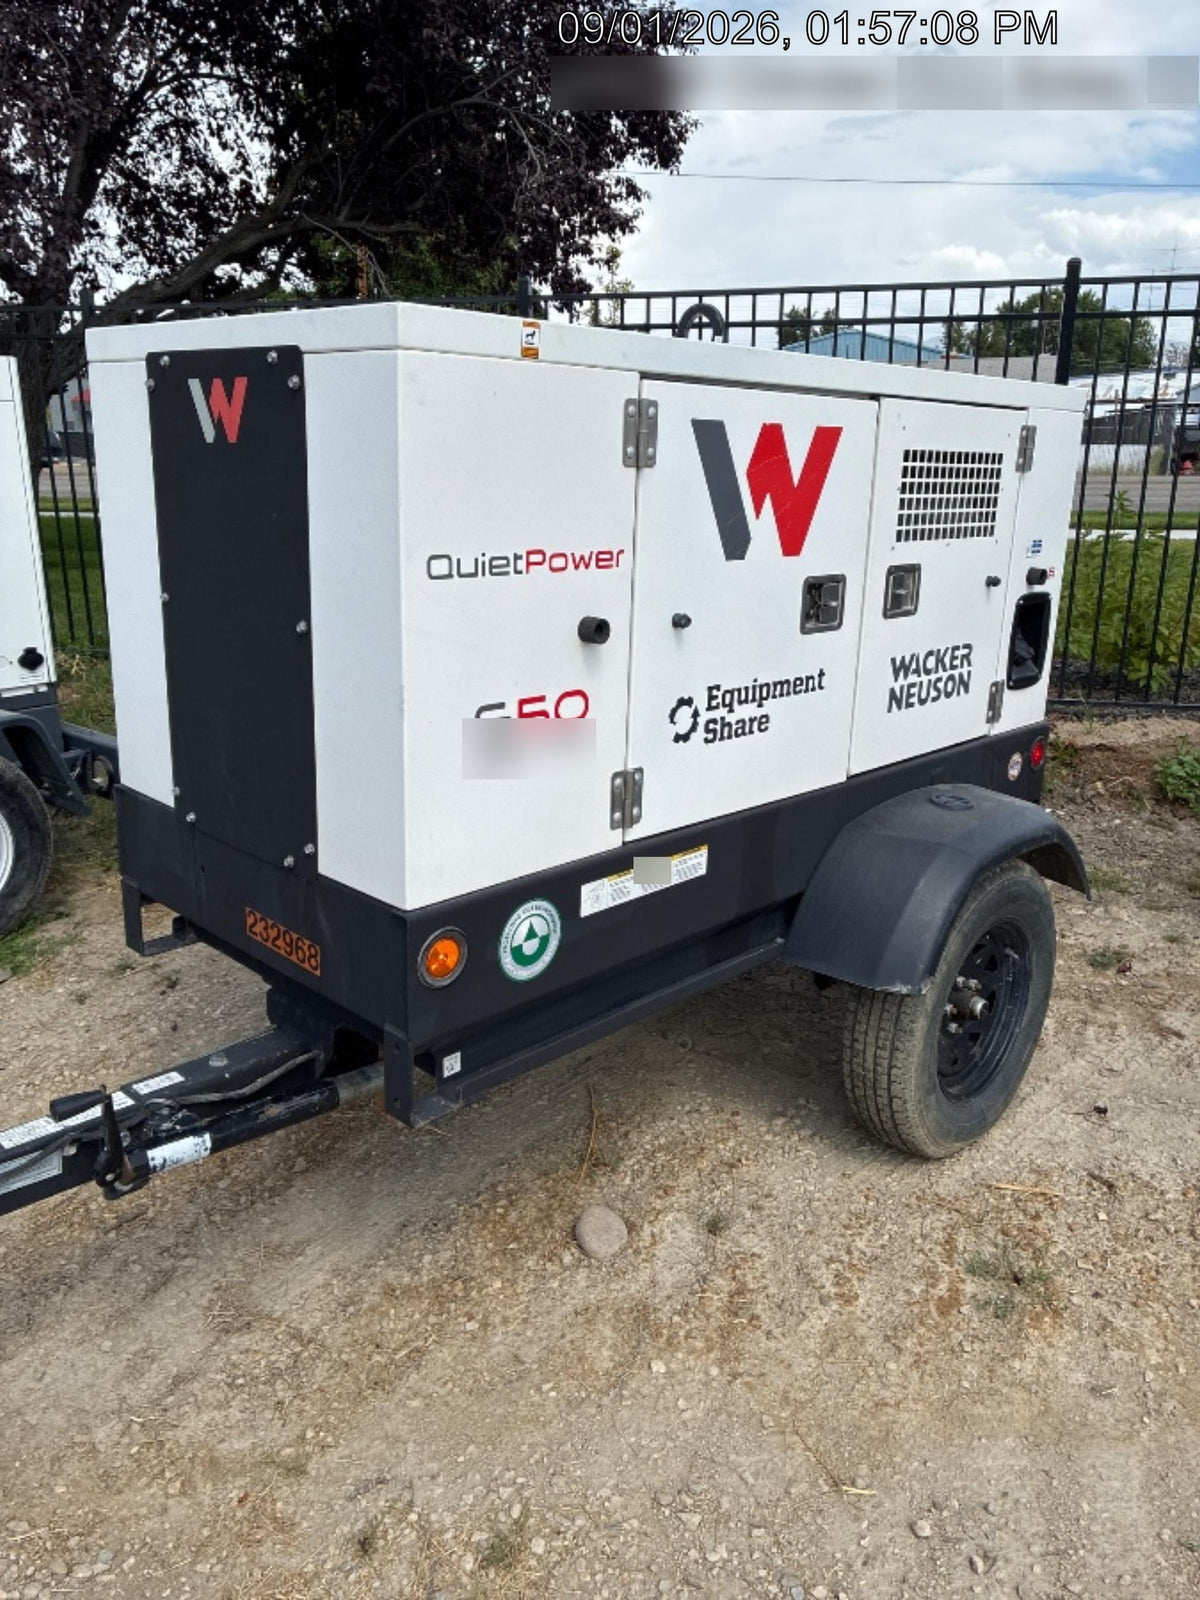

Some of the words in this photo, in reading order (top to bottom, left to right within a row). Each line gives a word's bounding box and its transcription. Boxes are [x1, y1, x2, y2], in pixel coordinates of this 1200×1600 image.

[426, 549, 625, 580] QuietPower
[890, 643, 973, 683] WACKER
[705, 668, 826, 713] Equipment
[887, 670, 972, 713] NEUSON
[703, 713, 770, 744] Share
[246, 909, 320, 972] 232968
